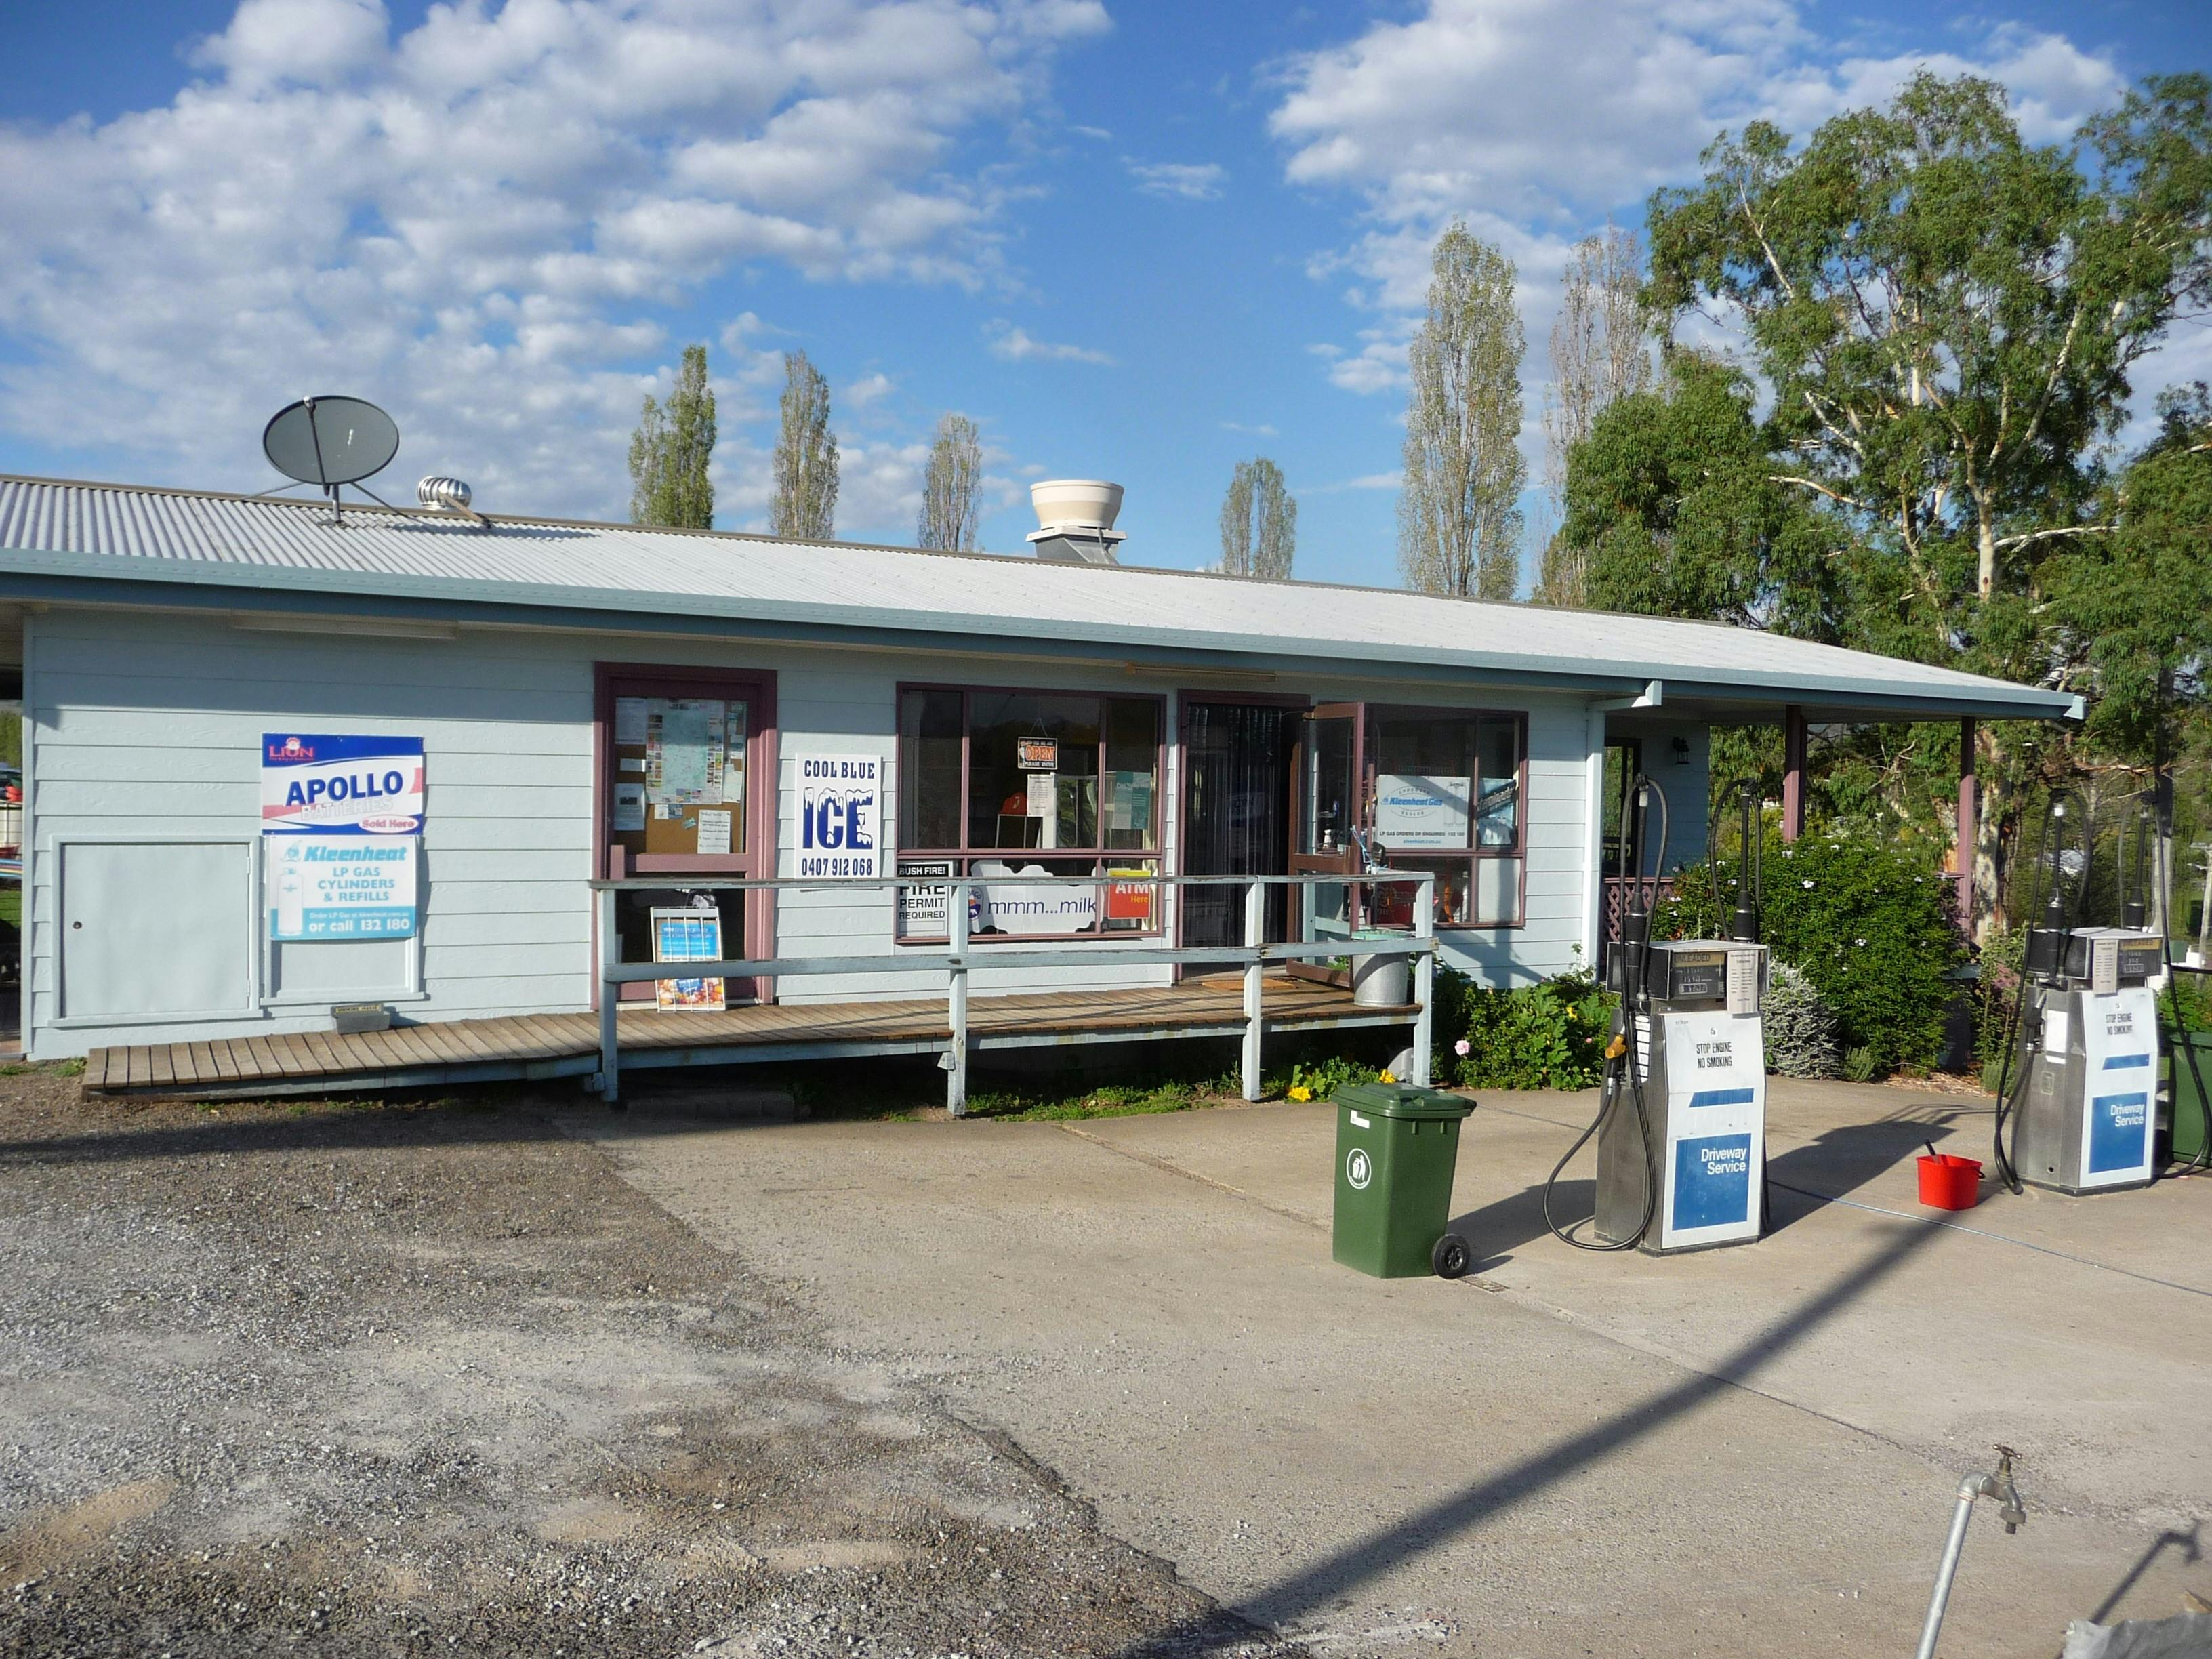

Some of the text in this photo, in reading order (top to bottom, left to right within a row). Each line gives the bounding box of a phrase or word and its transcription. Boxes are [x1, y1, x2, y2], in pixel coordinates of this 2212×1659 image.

[268, 745, 314, 758] LION
[1025, 745, 1055, 762] OPEN
[804, 760, 875, 779] COOL BLUE
[285, 770, 404, 807] APOLLO
[1389, 797, 1429, 806] Kleenheat
[300, 796, 393, 821] BATTERIES
[362, 819, 415, 829] Sold Here
[802, 787, 874, 850] ICE
[304, 846, 407, 862] Kleenheat
[333, 867, 380, 877] LP GAS
[802, 858, 872, 876] 0407 912 068
[899, 867, 922, 876] BUSH
[318, 879, 394, 889] CYLINDERS
[324, 891, 389, 902] & REFILLS
[1130, 895, 1149, 903] Here
[899, 898, 945, 909] PERMIT
[988, 897, 1096, 914] mmm...milk
[899, 910, 945, 920] REQUIRED
[309, 918, 410, 933] or call 132 180
[1696, 1041, 1732, 1054] STOP ENGINE
[1698, 1056, 1733, 1068] NO SMOKING
[2110, 1104, 2145, 1116] Driveway
[2114, 1114, 2144, 1127] Service
[1701, 1147, 1747, 1162] Driveway
[1707, 1160, 1746, 1175] Service
